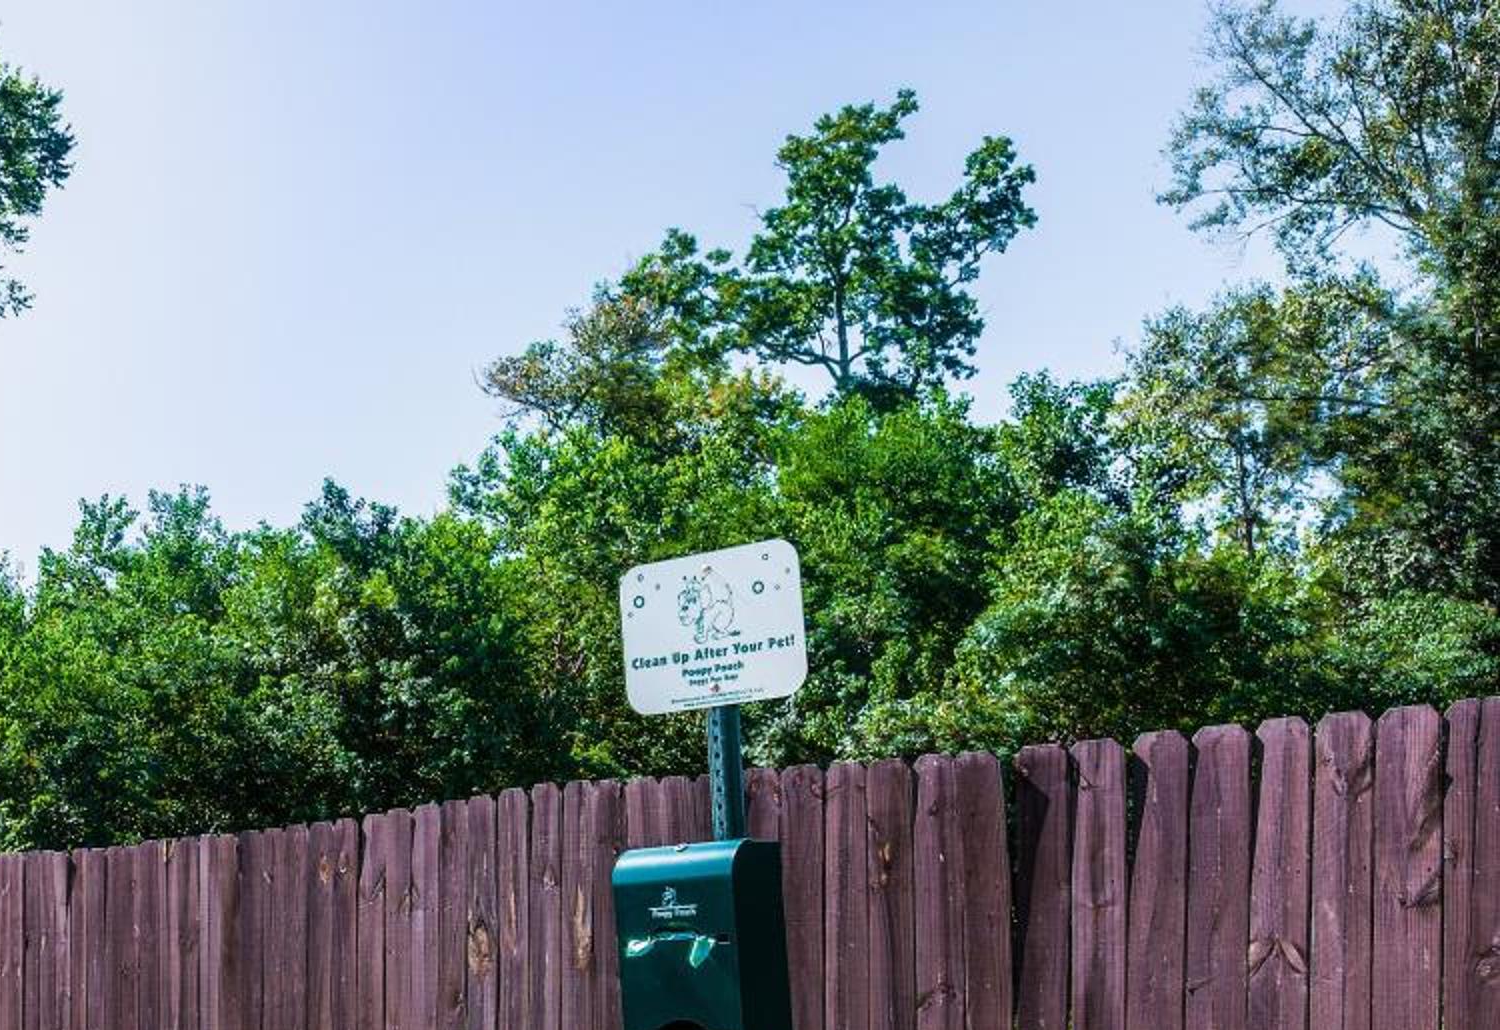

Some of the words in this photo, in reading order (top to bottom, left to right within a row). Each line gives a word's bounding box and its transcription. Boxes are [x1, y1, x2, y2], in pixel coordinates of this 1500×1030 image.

[632, 657, 667, 670] Clean
[672, 652, 689, 665] Up
[694, 648, 728, 661] After
[732, 641, 762, 654] Your
[768, 634, 795, 649] Pet!
